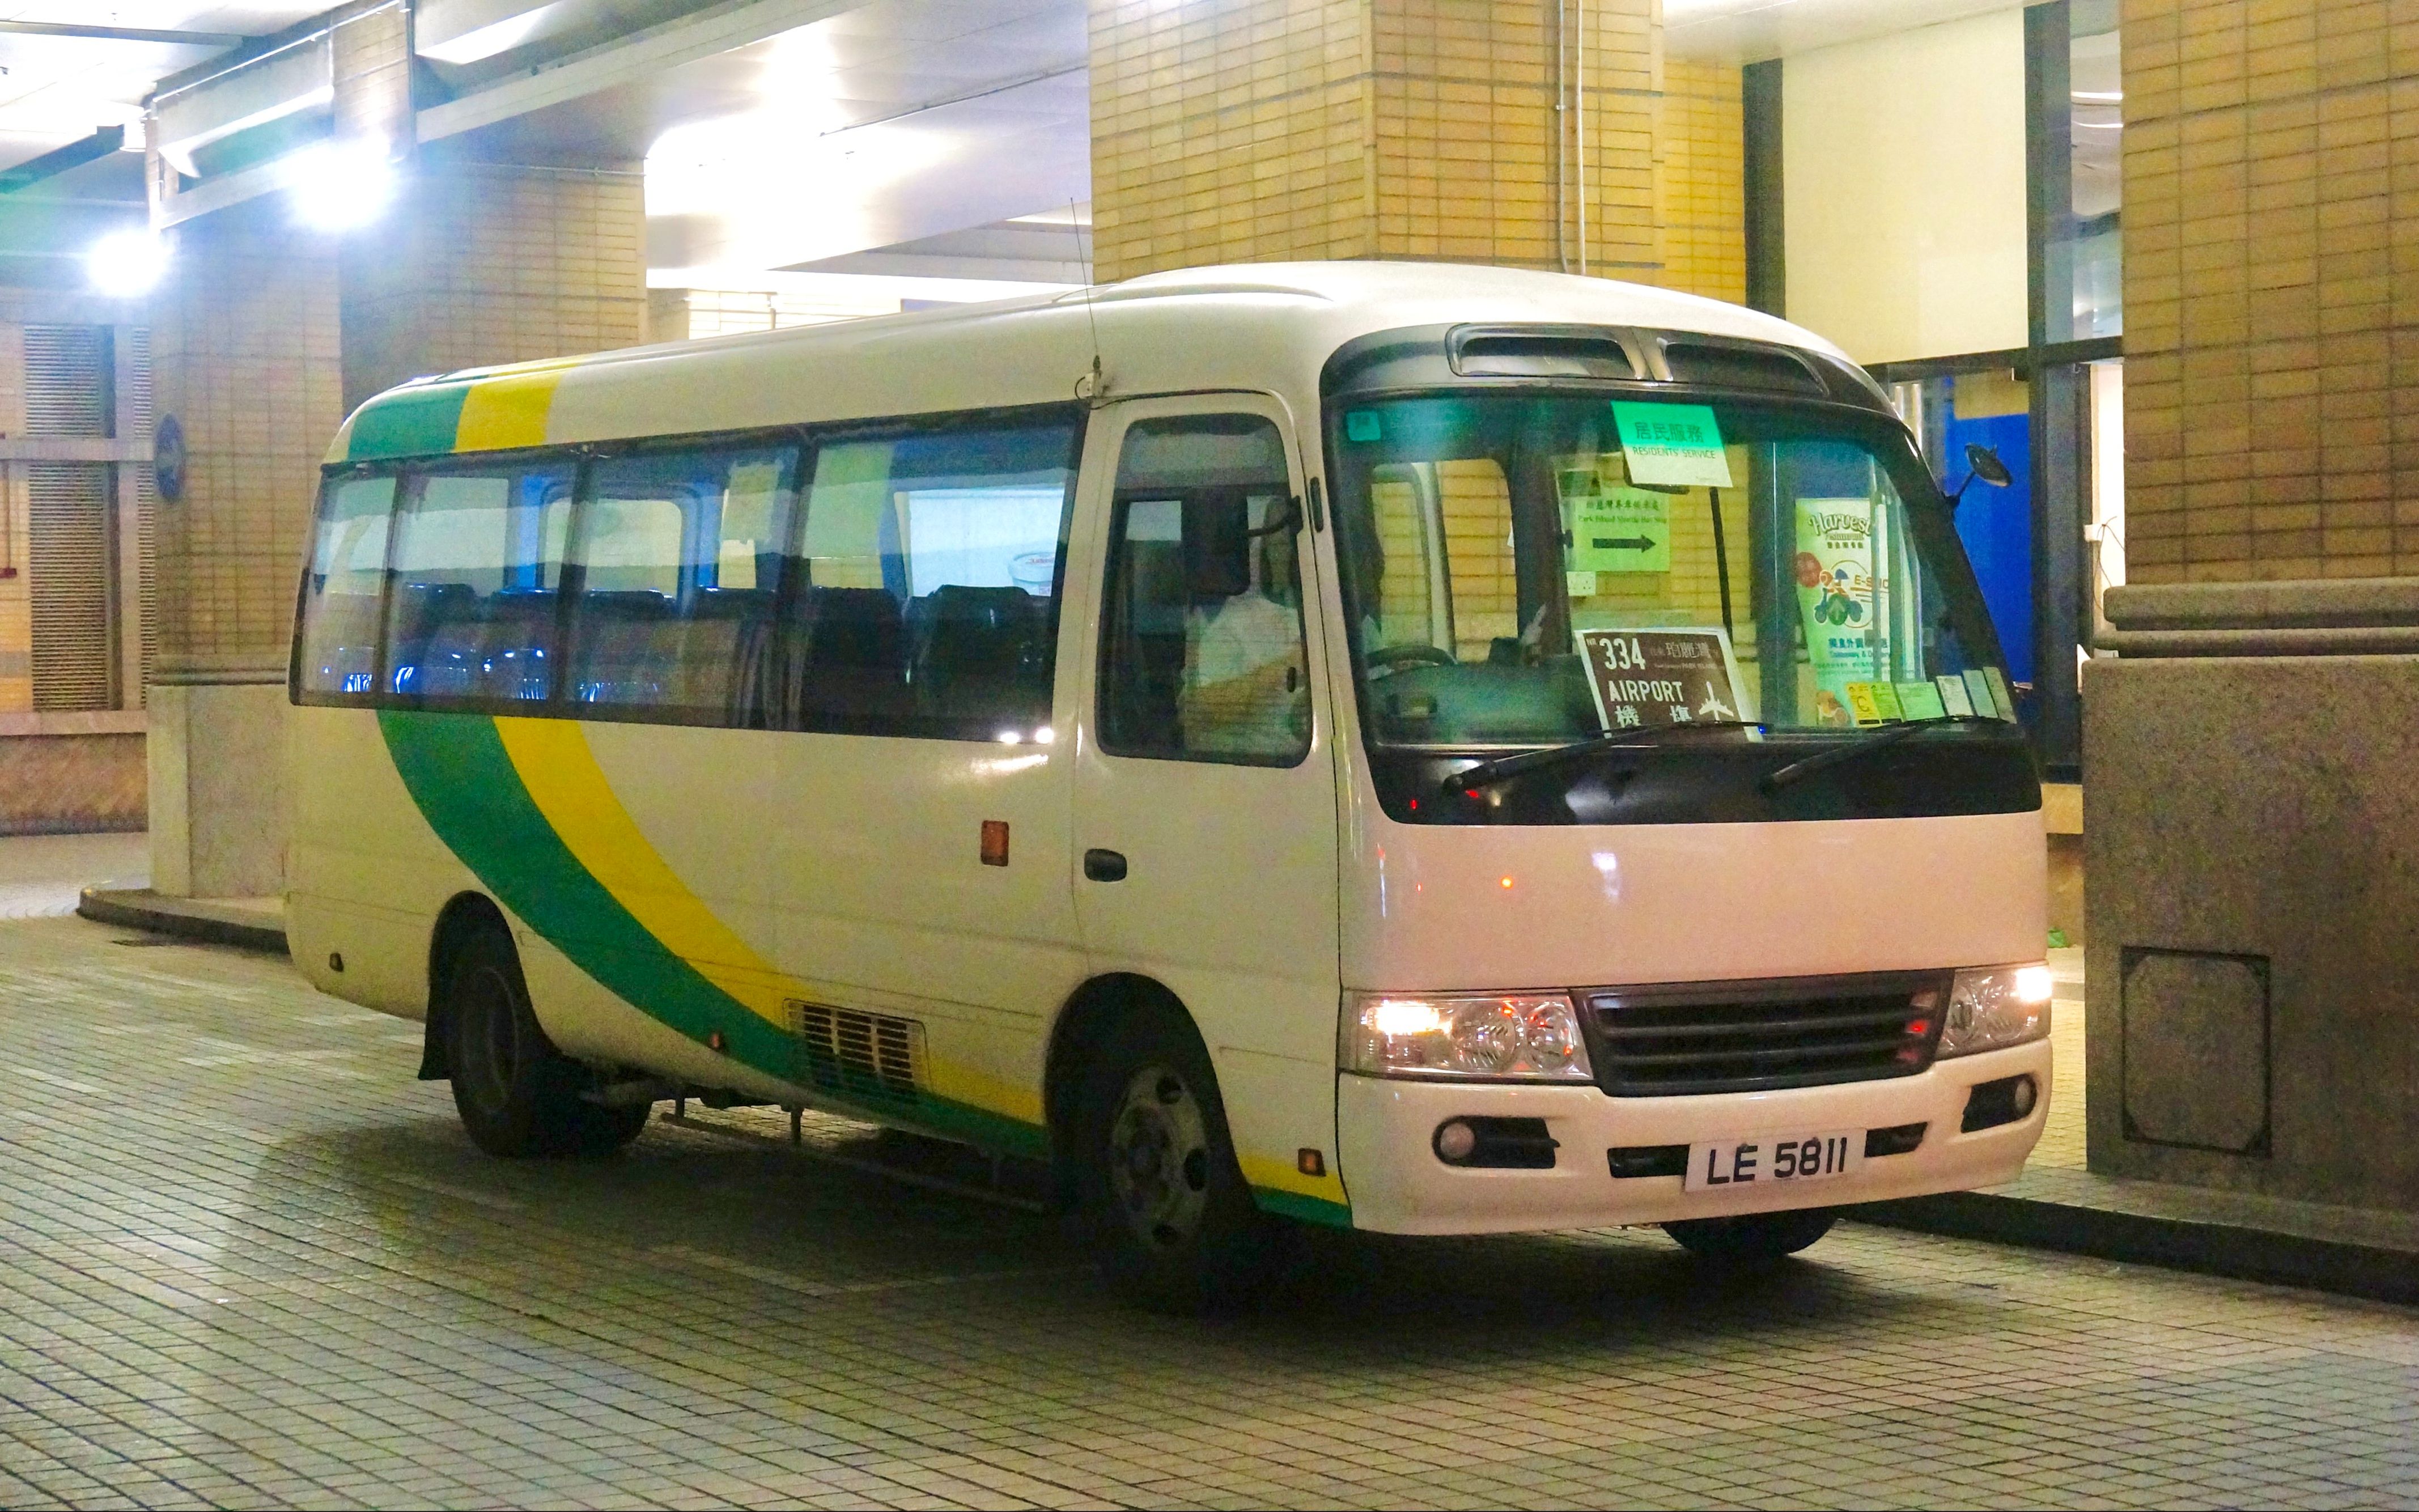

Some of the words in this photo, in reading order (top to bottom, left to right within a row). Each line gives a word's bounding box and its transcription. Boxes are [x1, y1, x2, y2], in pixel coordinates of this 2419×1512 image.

[1635, 422, 1704, 443] 居民服務
[1682, 449, 1716, 459] SERVICE
[1808, 512, 1871, 536] Harvest
[1599, 638, 1646, 670] 334
[1608, 680, 1684, 702] AIRPORT
[1707, 1145, 1758, 1185] LE
[1774, 1137, 1847, 1179] 5811
